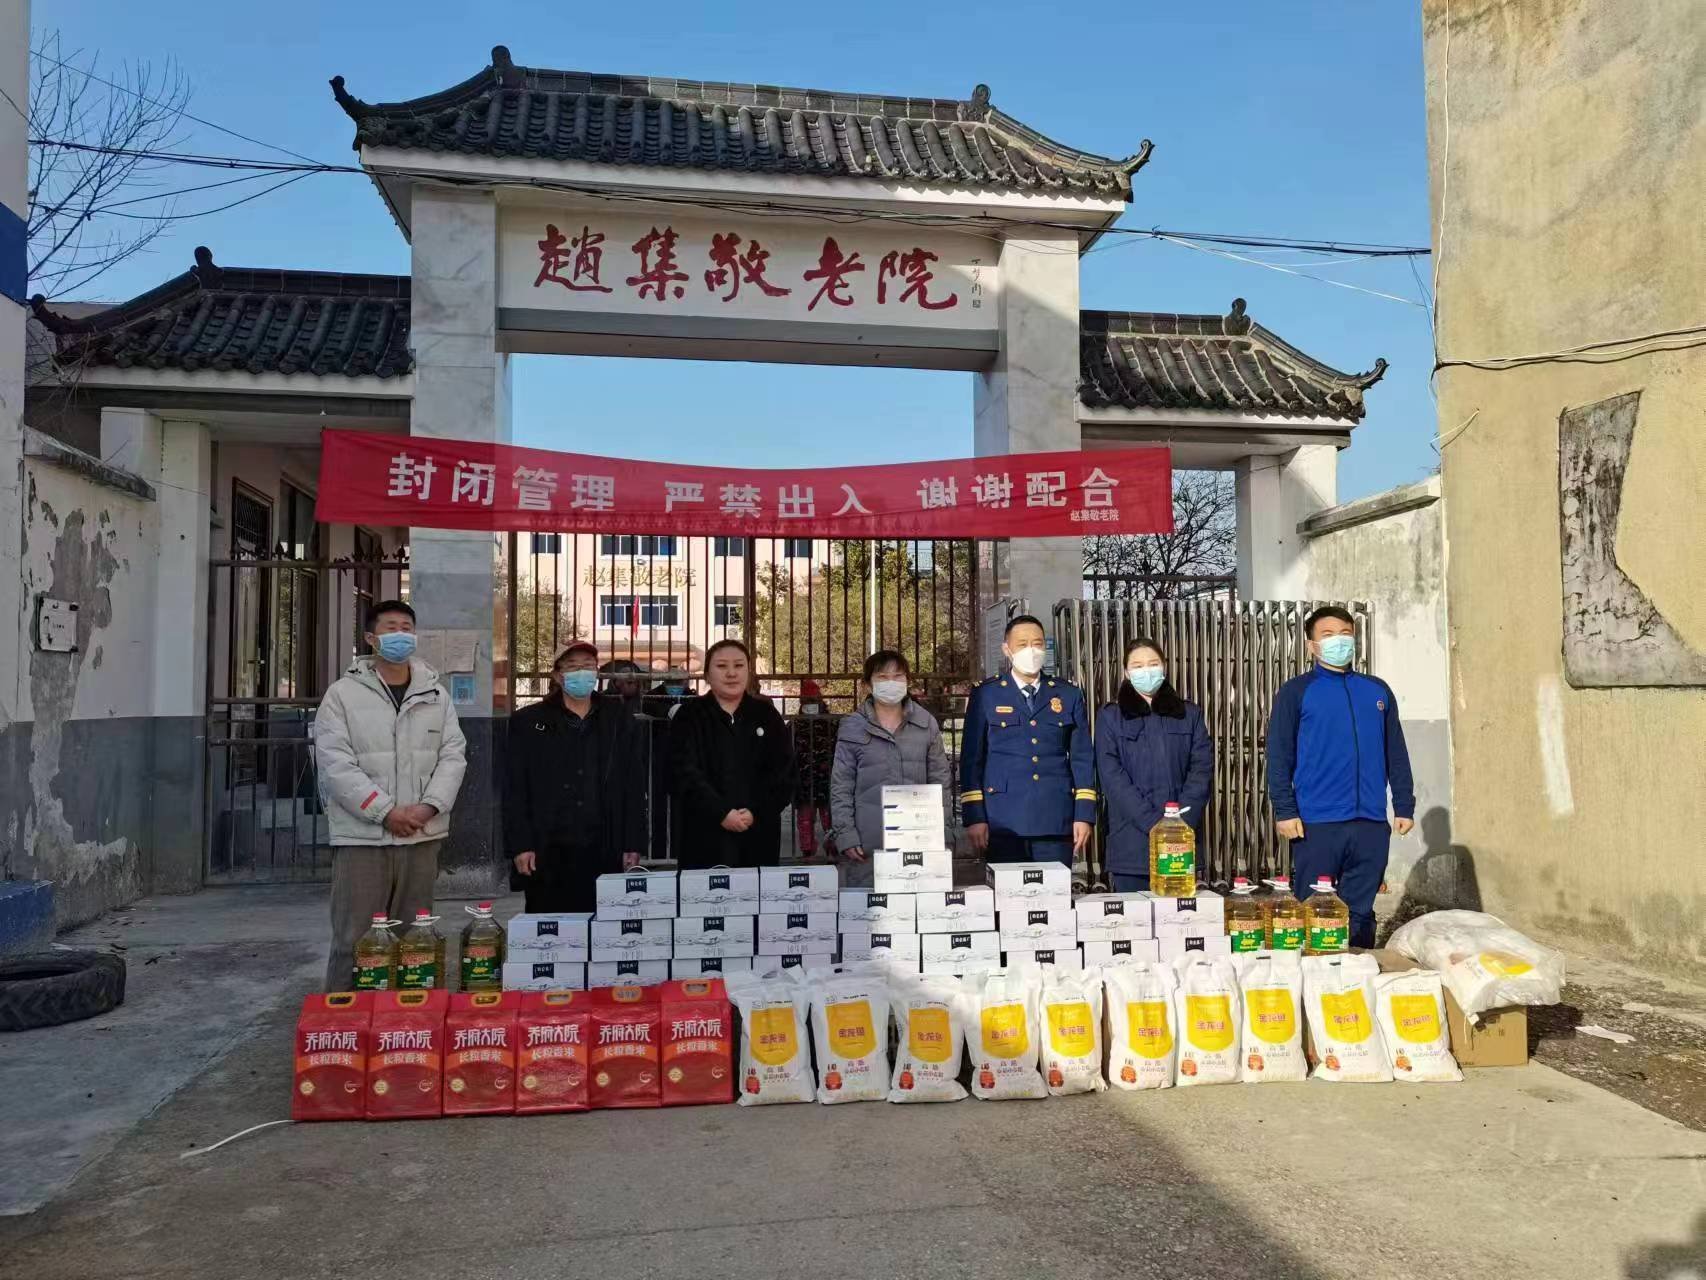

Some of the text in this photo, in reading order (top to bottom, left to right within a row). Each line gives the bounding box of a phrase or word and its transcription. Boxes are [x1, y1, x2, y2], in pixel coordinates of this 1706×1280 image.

[533, 223, 957, 311] 趙集敬老院
[387, 452, 1120, 519] 封闭管理 严禁出入 谢谢配合
[1070, 508, 1120, 521] 赵集敬老院
[583, 565, 697, 589] 赵集敬老院
[453, 1027, 507, 1049] 乔府大院
[526, 1024, 580, 1046] 乔府大院
[599, 1023, 650, 1044] 乔府大院
[671, 1018, 722, 1041] 乔府大院
[304, 1031, 358, 1052] 乔府大院
[378, 1030, 432, 1052] 乔府大院
